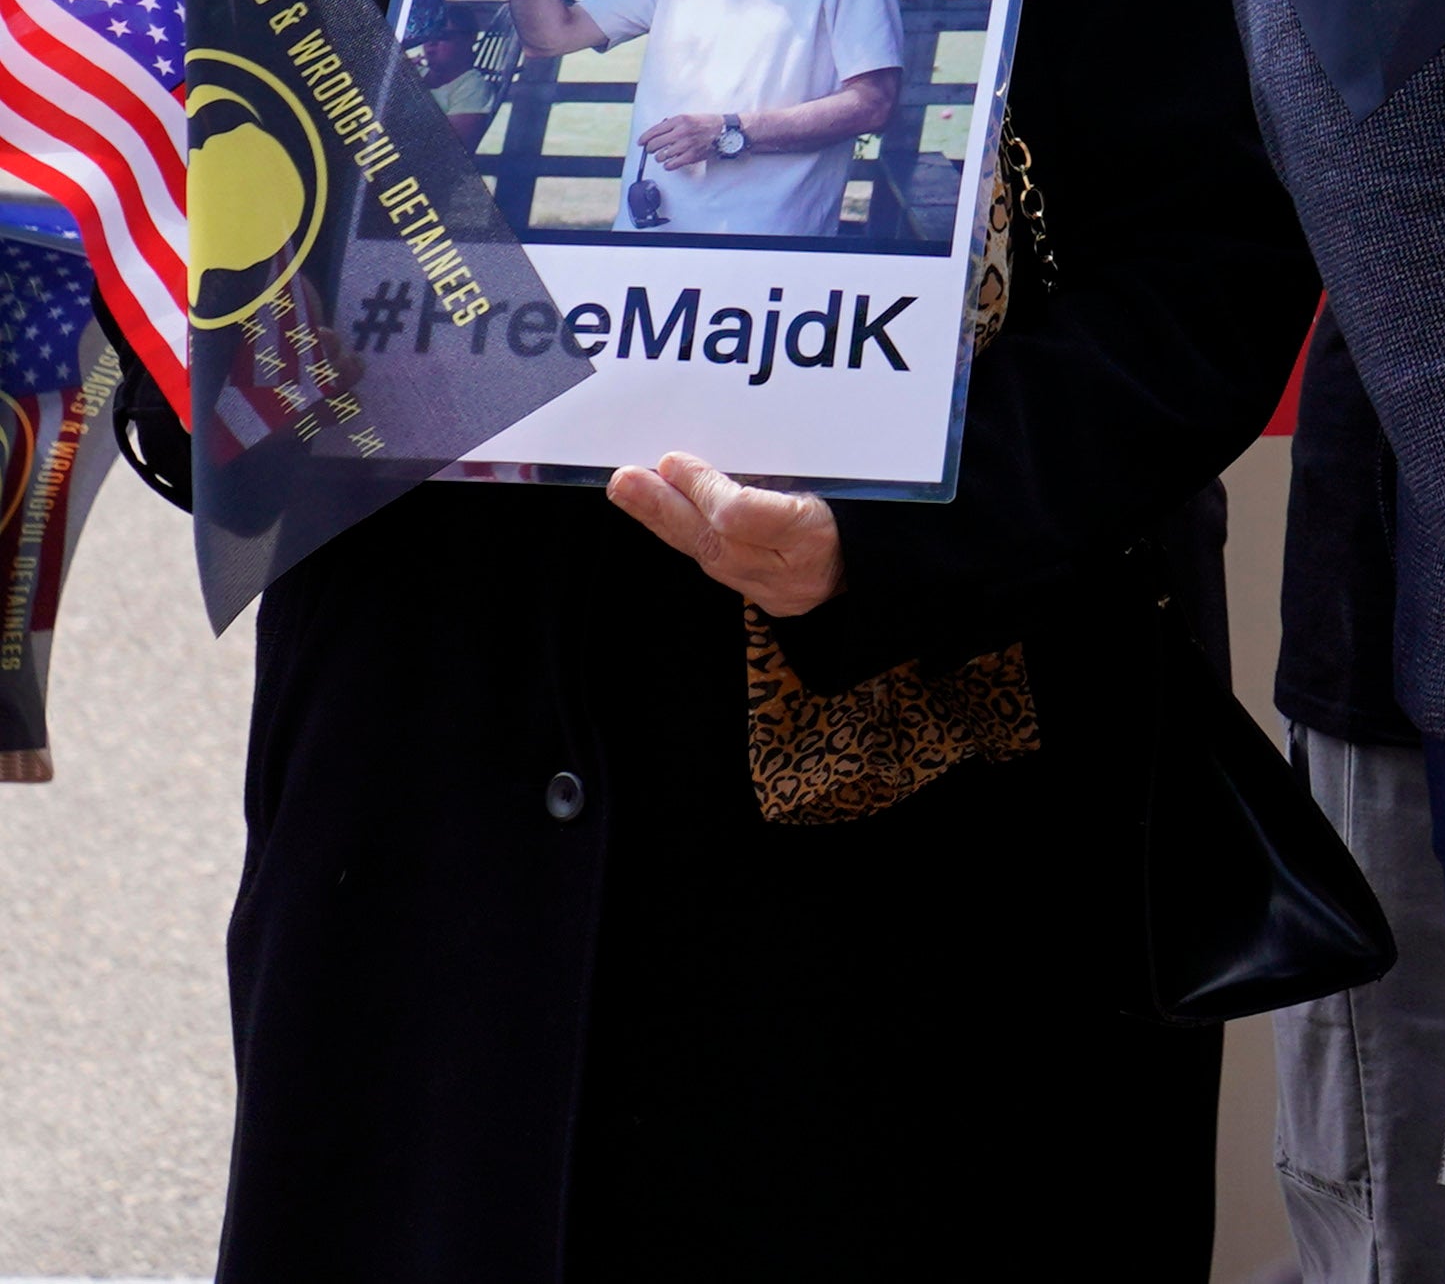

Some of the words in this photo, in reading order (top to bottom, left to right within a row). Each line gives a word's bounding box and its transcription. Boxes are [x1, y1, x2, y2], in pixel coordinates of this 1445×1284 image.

[270, 2, 307, 35] &
[287, 28, 400, 182] WRONGFUL
[379, 175, 490, 327] DETAINEES
[351, 280, 918, 386] #FreeMajdK
